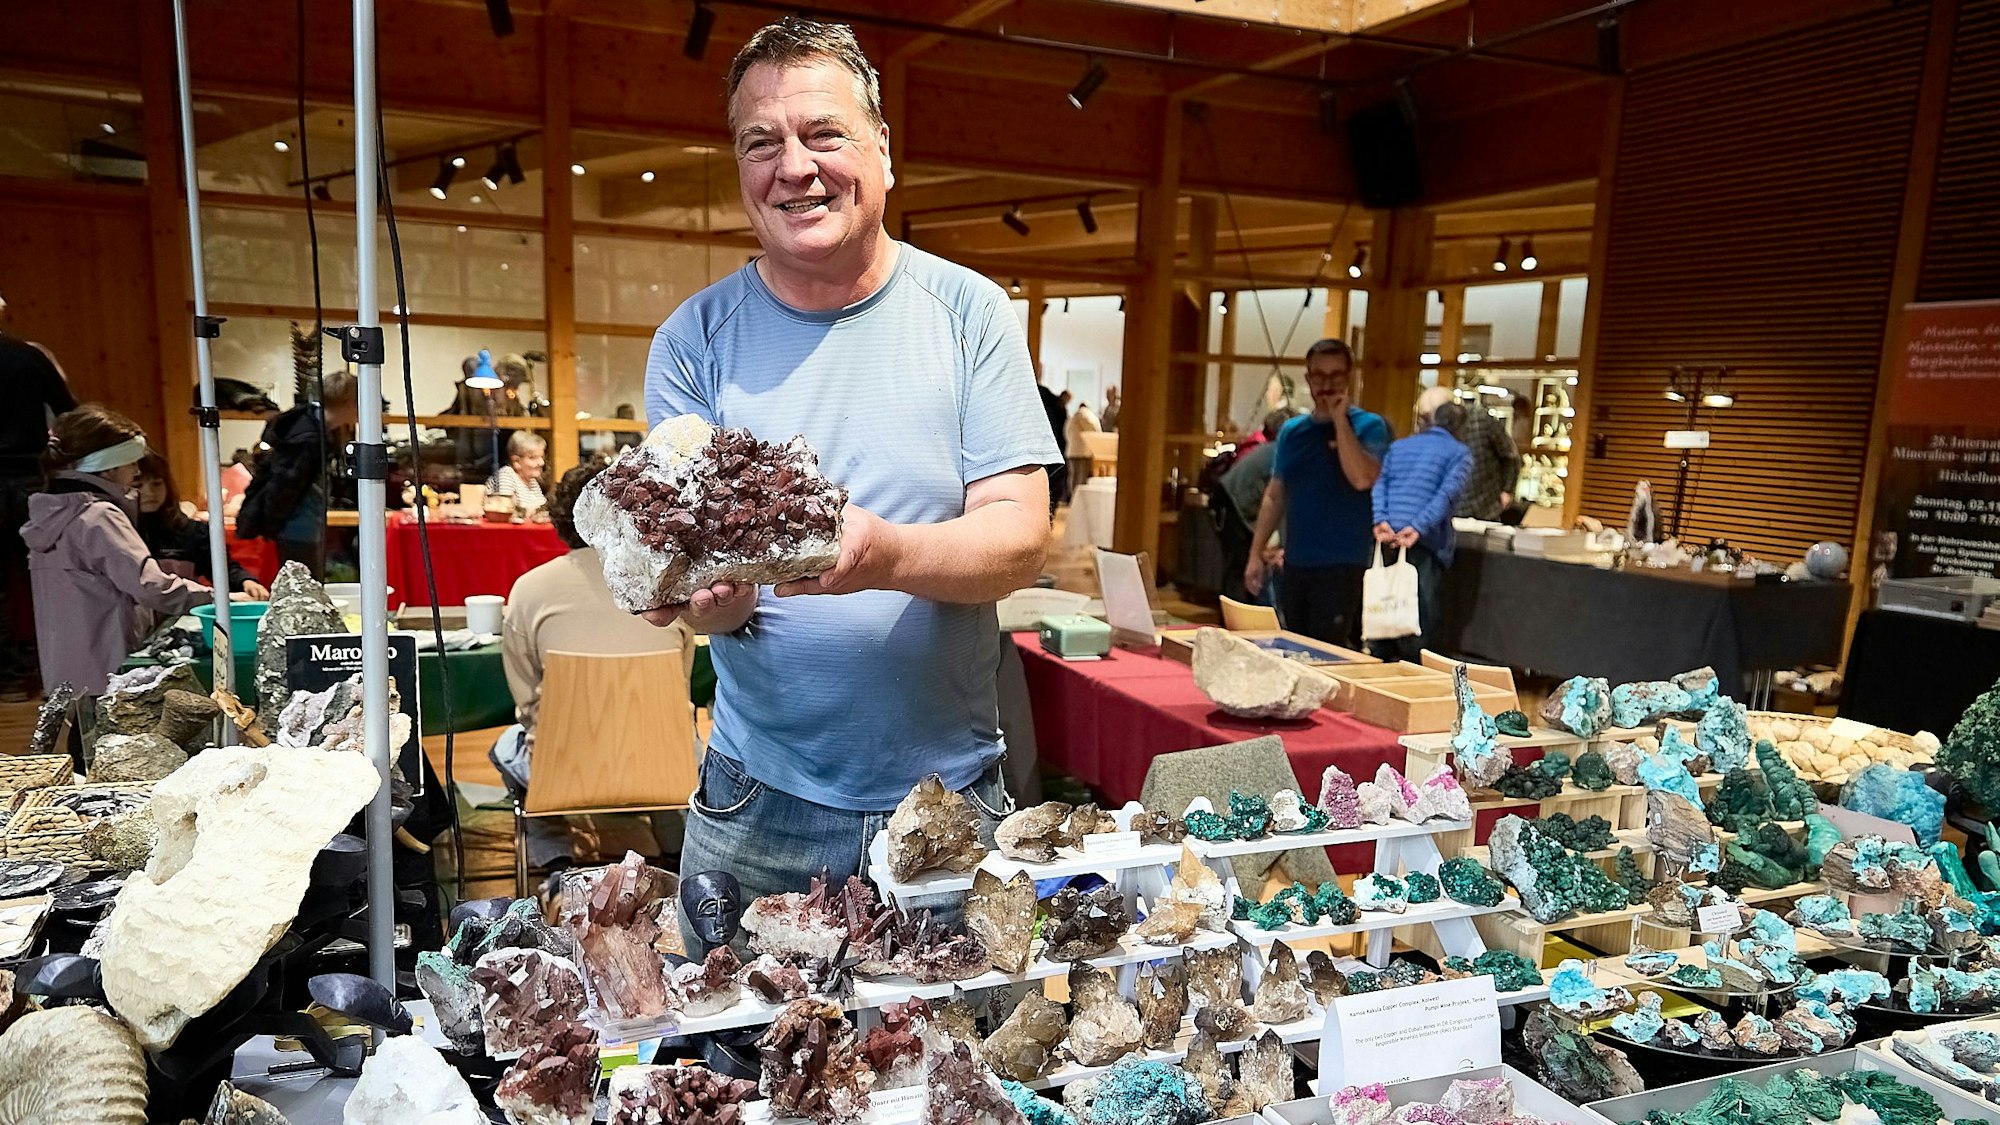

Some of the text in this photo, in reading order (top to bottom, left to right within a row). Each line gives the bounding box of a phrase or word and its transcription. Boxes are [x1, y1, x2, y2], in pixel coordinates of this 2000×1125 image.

[1923, 325, 1979, 337] Museum
[1963, 450, 1987, 463] und
[1914, 494, 1966, 511] Sonntag,
[1907, 509, 1929, 520] von
[1934, 510, 1968, 523] 10:00
[310, 644, 398, 661] Maroo
[1382, 1003, 1398, 1011] Copper
[1383, 1031, 1398, 1039] Copper
[1408, 1024, 1423, 1033] Cobalt
